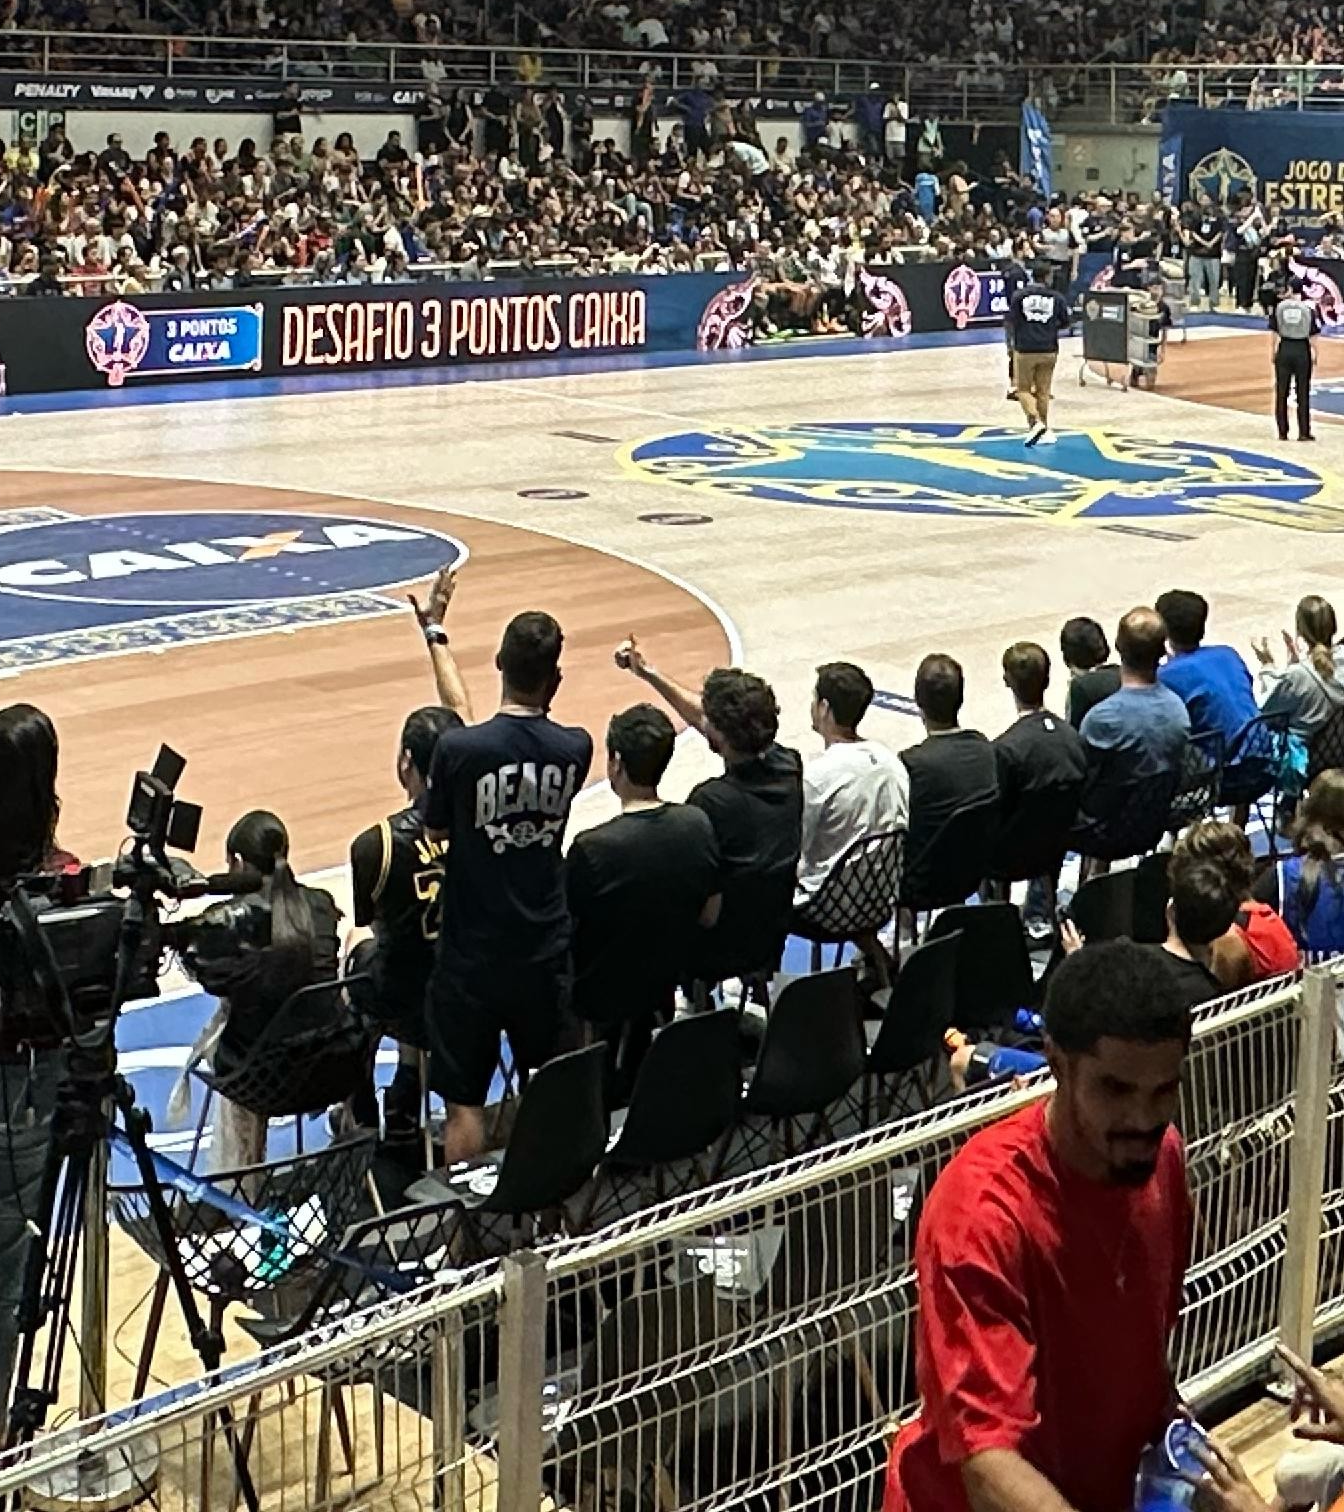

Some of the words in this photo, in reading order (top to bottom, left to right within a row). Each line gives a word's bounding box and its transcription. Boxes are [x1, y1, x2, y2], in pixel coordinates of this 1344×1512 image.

[1285, 160, 1332, 181] JOGO
[167, 322, 177, 339] 3
[180, 318, 238, 338] PONTOS
[283, 300, 413, 367] DESAFIO
[421, 300, 442, 358] 3
[449, 293, 562, 358] PONTOS
[568, 289, 647, 350] CAIXA
[169, 342, 232, 364] CAIXA
